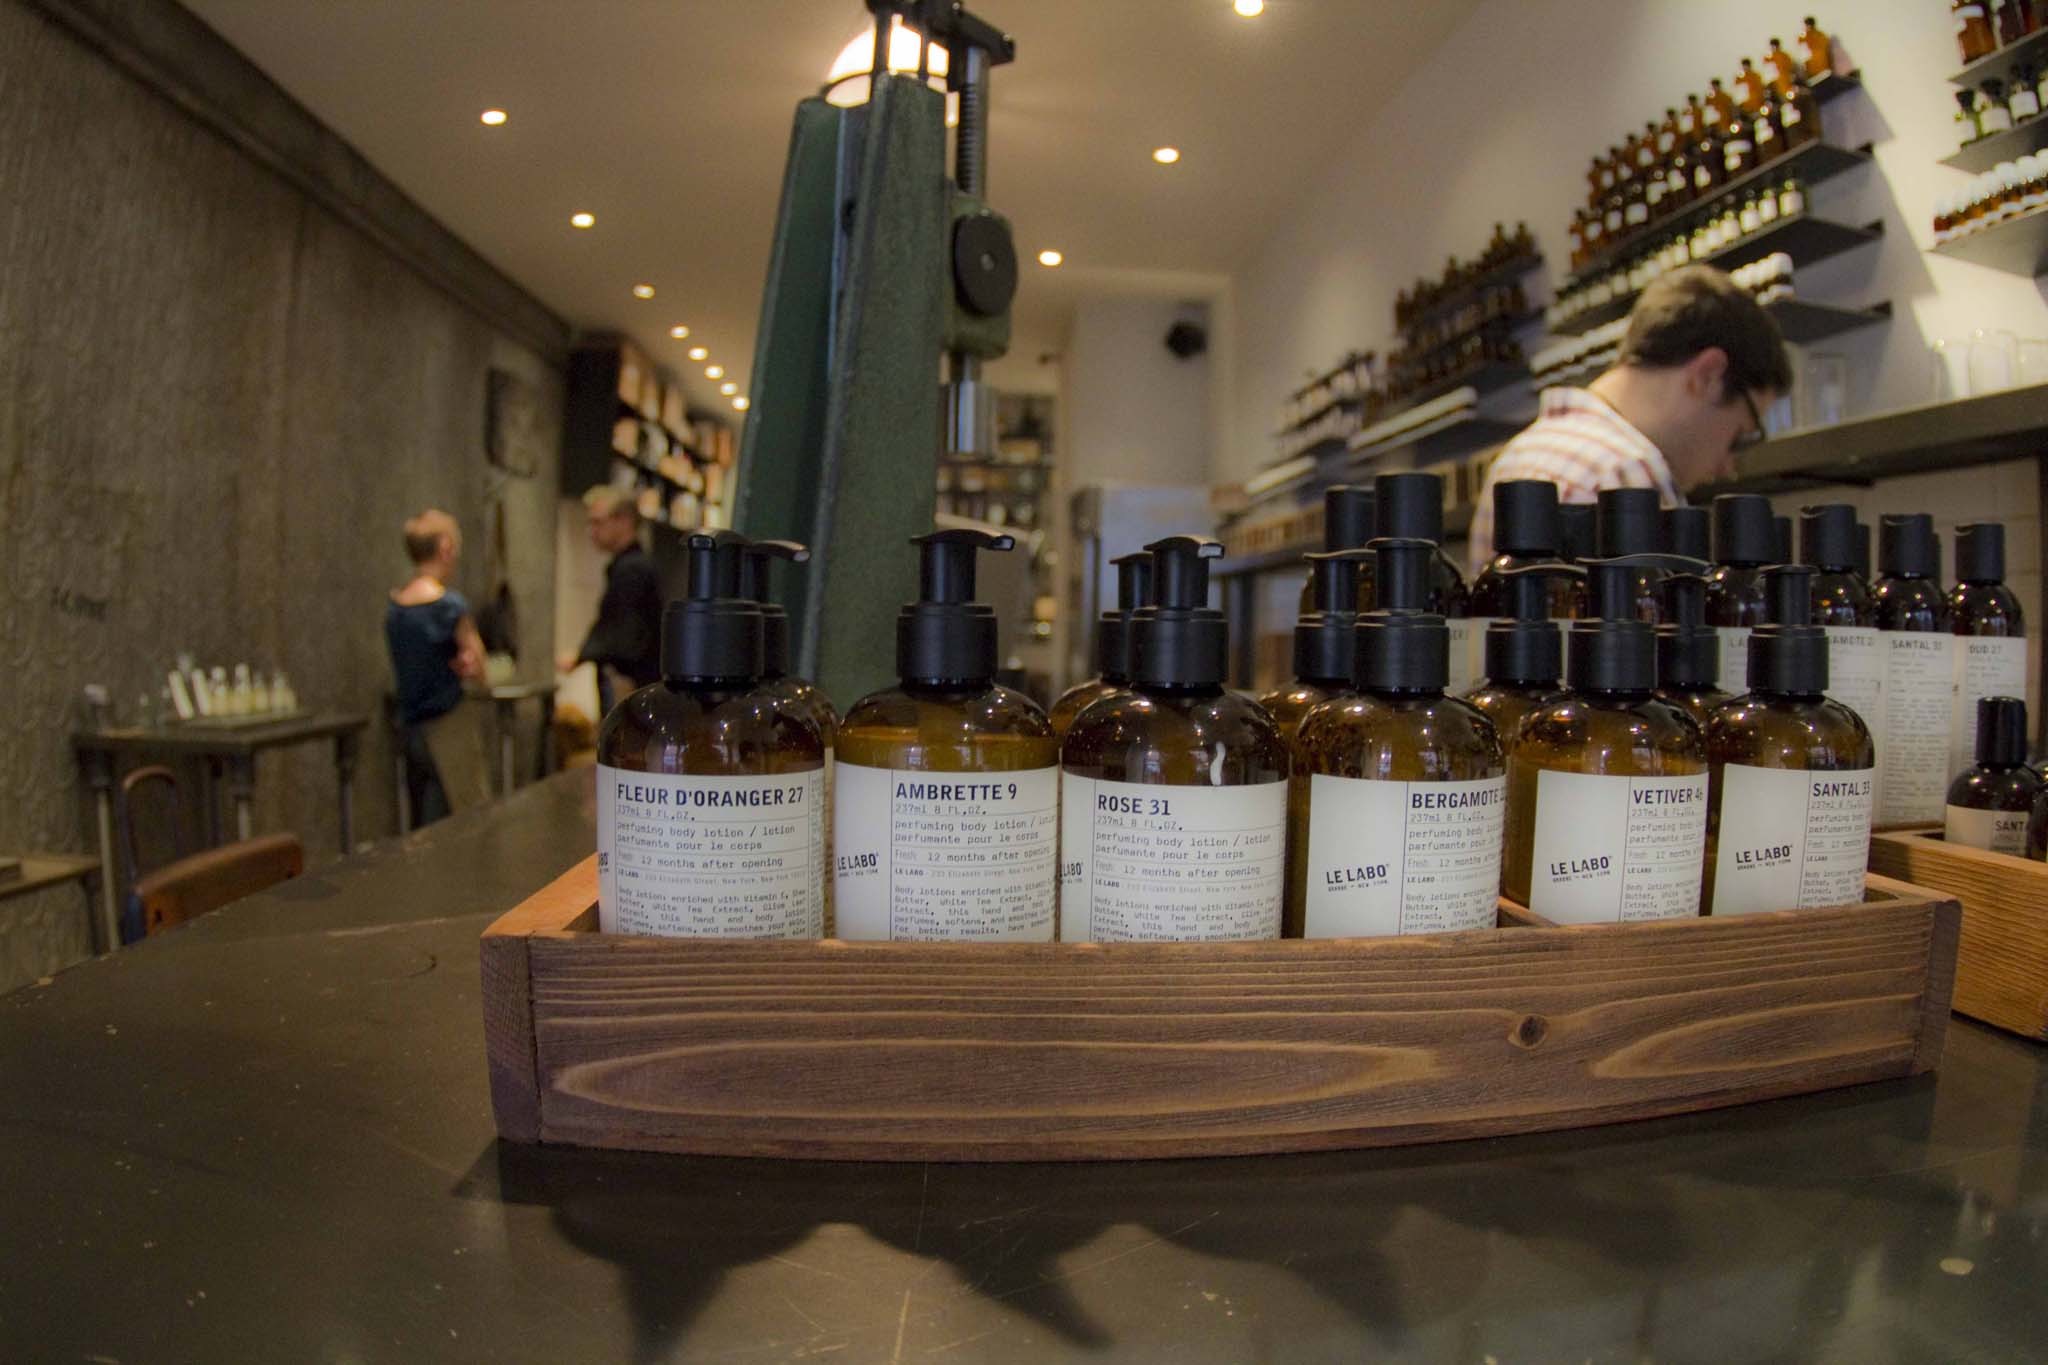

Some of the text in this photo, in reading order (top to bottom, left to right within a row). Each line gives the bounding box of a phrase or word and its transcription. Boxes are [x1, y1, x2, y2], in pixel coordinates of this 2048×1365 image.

[1892, 639, 1929, 650] SANTAL
[617, 783, 804, 807] FLEUR D'ORANGER 27
[896, 782, 1017, 801] AMBRETTE 9
[1633, 788, 1693, 804] VETIVER
[1813, 782, 1860, 797] SANTAL
[1098, 794, 1171, 816] ROSE 31
[1412, 788, 1498, 809] BERGAMOTE
[895, 803, 927, 814] 237ml
[934, 804, 941, 815] 8
[1096, 815, 1123, 826] 237ml
[1411, 813, 1440, 822] 237ml
[617, 822, 664, 837] perfuming
[670, 825, 696, 839] body
[704, 826, 744, 838] lotion
[763, 823, 795, 837] lotion
[895, 820, 954, 832] perfuming
[961, 821, 986, 832] body
[993, 820, 1027, 830] lotion
[1995, 820, 2025, 832] SANT
[968, 835, 993, 846] pour
[1000, 833, 1010, 843] le
[1016, 831, 1039, 842] corps
[1096, 831, 1150, 846] perfuming
[1156, 837, 1184, 848] body
[1191, 837, 1228, 847] lotion
[1409, 829, 1463, 839] perfuming
[676, 839, 703, 851] pour
[711, 838, 723, 850] le
[730, 840, 762, 852] corps
[928, 852, 941, 862] 12
[946, 853, 985, 863] months
[992, 851, 1019, 862] after
[1162, 851, 1189, 861] pour
[1197, 850, 1209, 860] le
[1215, 851, 1244, 861] corps
[1736, 851, 1752, 864] LE
[1755, 845, 1790, 861] LABO
[641, 856, 652, 865] 12
[657, 856, 695, 869] months
[702, 858, 735, 869] after
[741, 857, 783, 870] opening
[837, 856, 847, 871] LE
[848, 853, 877, 869] LABO
[1440, 858, 1450, 868] 12
[1551, 856, 1609, 875] LE LABO
[1123, 864, 1136, 875] 12
[1142, 867, 1181, 878] months
[1188, 868, 1218, 878] after
[1225, 865, 1260, 879] opening
[1326, 864, 1386, 884] LE LABO
[961, 887, 1001, 897] enriched
[718, 895, 739, 904] with
[728, 915, 744, 923] and
[755, 913, 773, 922] body
[768, 922, 785, 932] your
